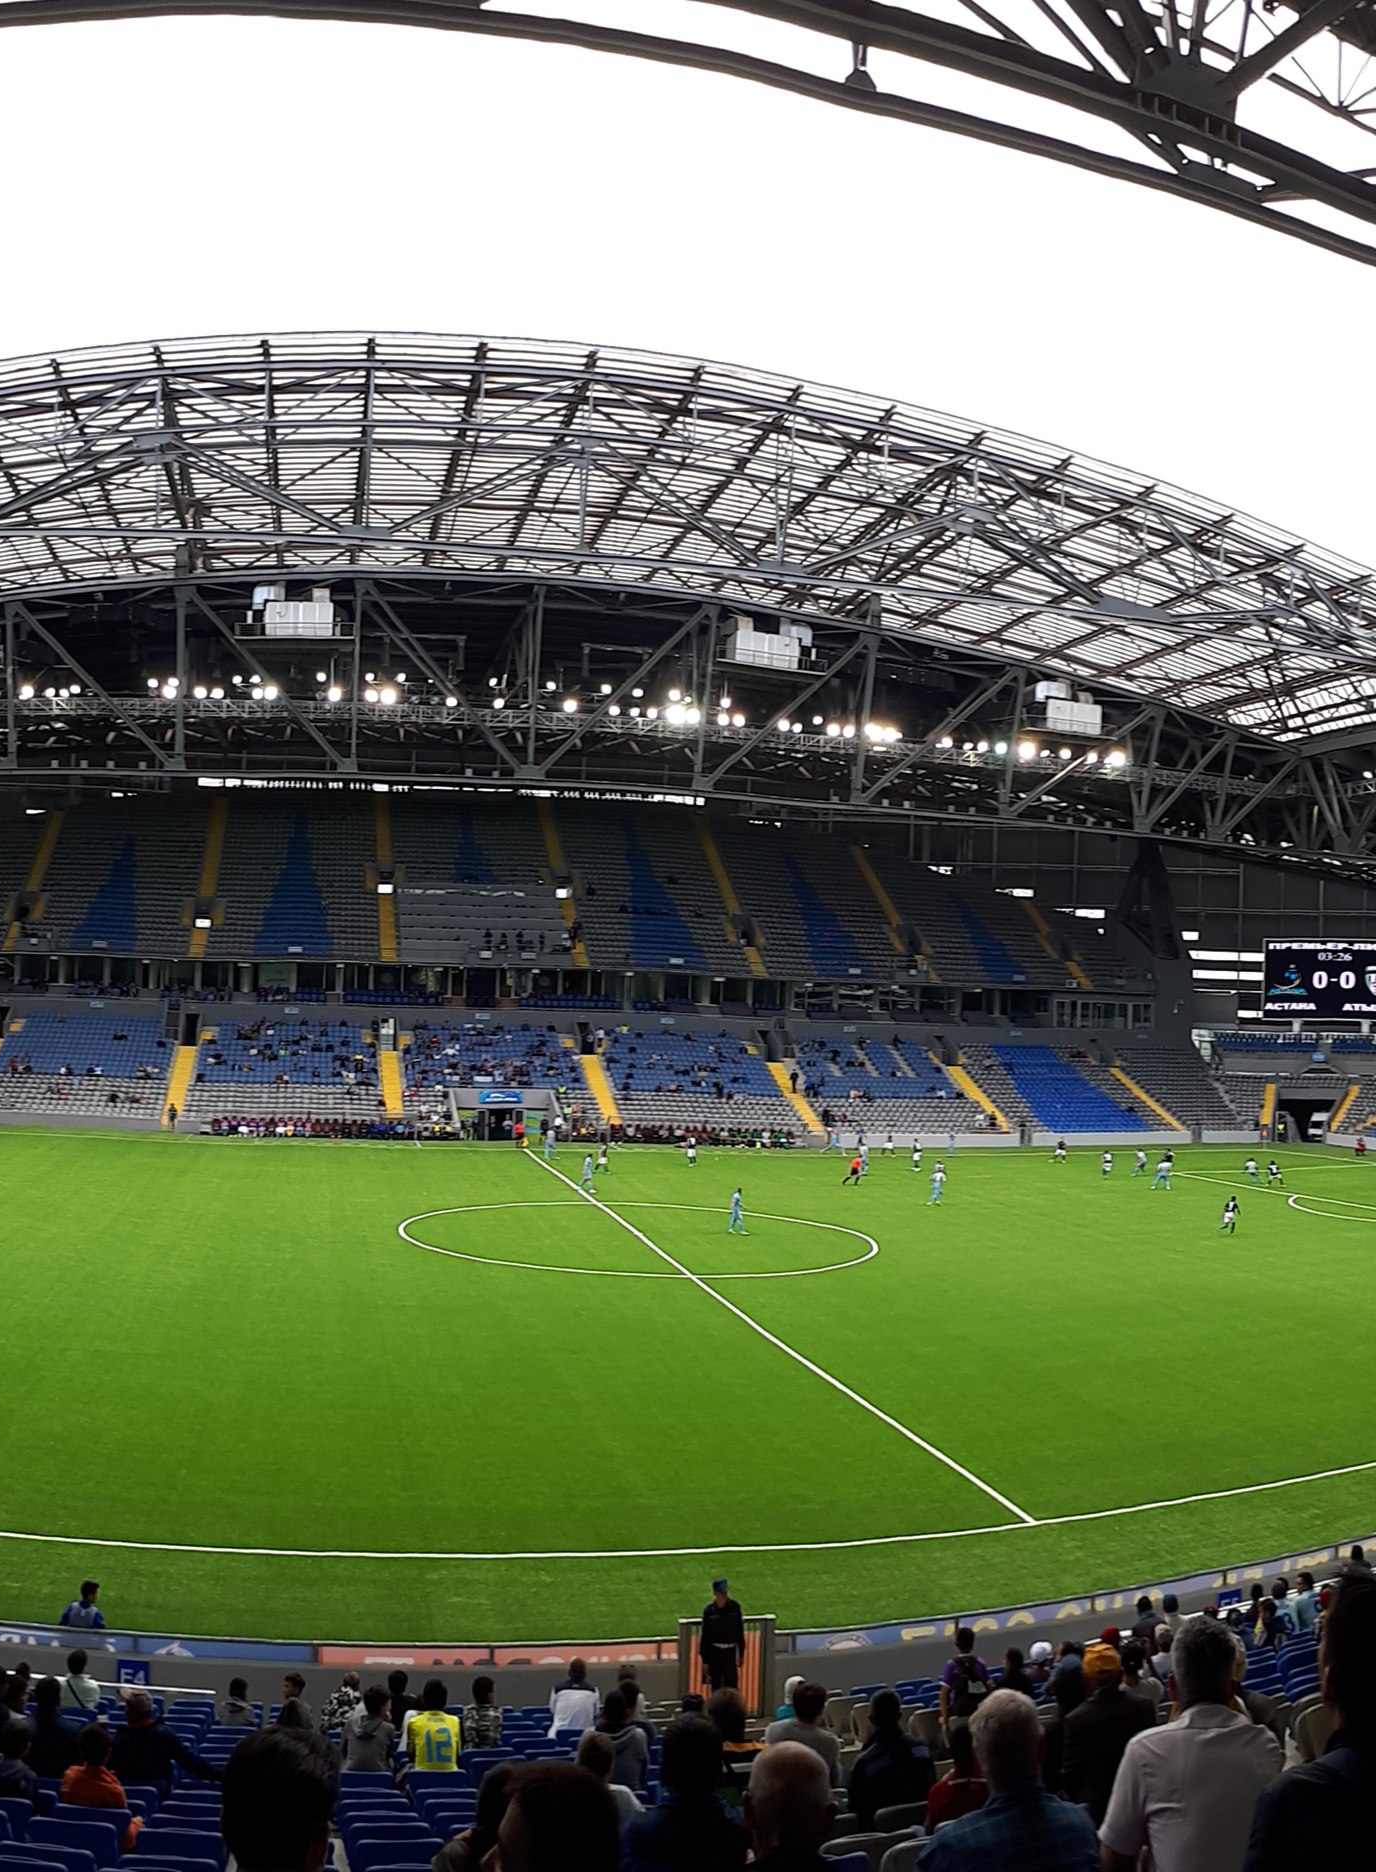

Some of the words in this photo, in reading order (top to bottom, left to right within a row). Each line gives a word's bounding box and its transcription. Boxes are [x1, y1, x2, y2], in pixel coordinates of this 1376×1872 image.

[1264, 1002, 1317, 1011] АСТАНА
[119, 1667, 147, 1685] E4
[425, 1727, 452, 1763] 12
